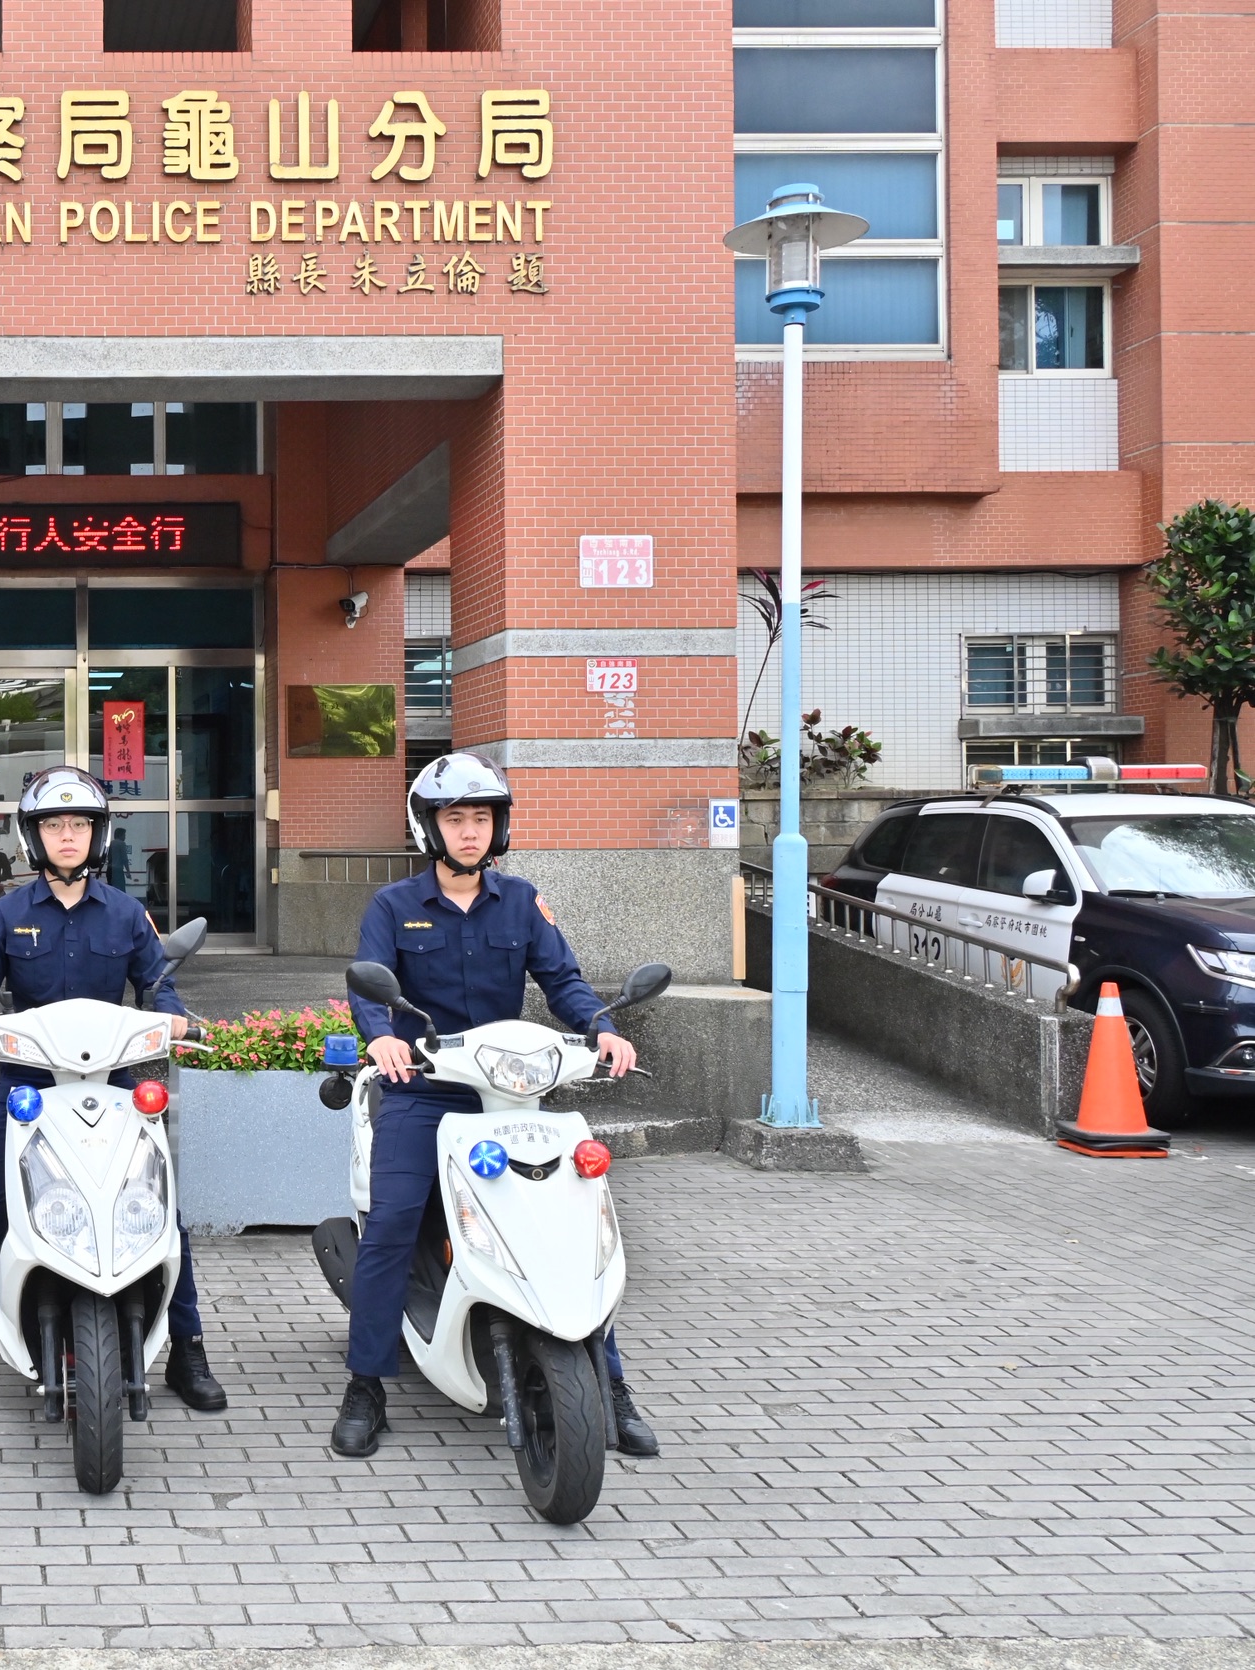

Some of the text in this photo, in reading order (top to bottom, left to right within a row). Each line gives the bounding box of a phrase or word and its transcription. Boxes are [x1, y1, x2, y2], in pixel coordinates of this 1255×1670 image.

[59, 200, 222, 243] POLICE
[250, 200, 552, 243] DEPARTMENT
[244, 250, 550, 296] 縣長 朱立倫 題
[598, 559, 648, 585] 123
[598, 672, 634, 690] 123
